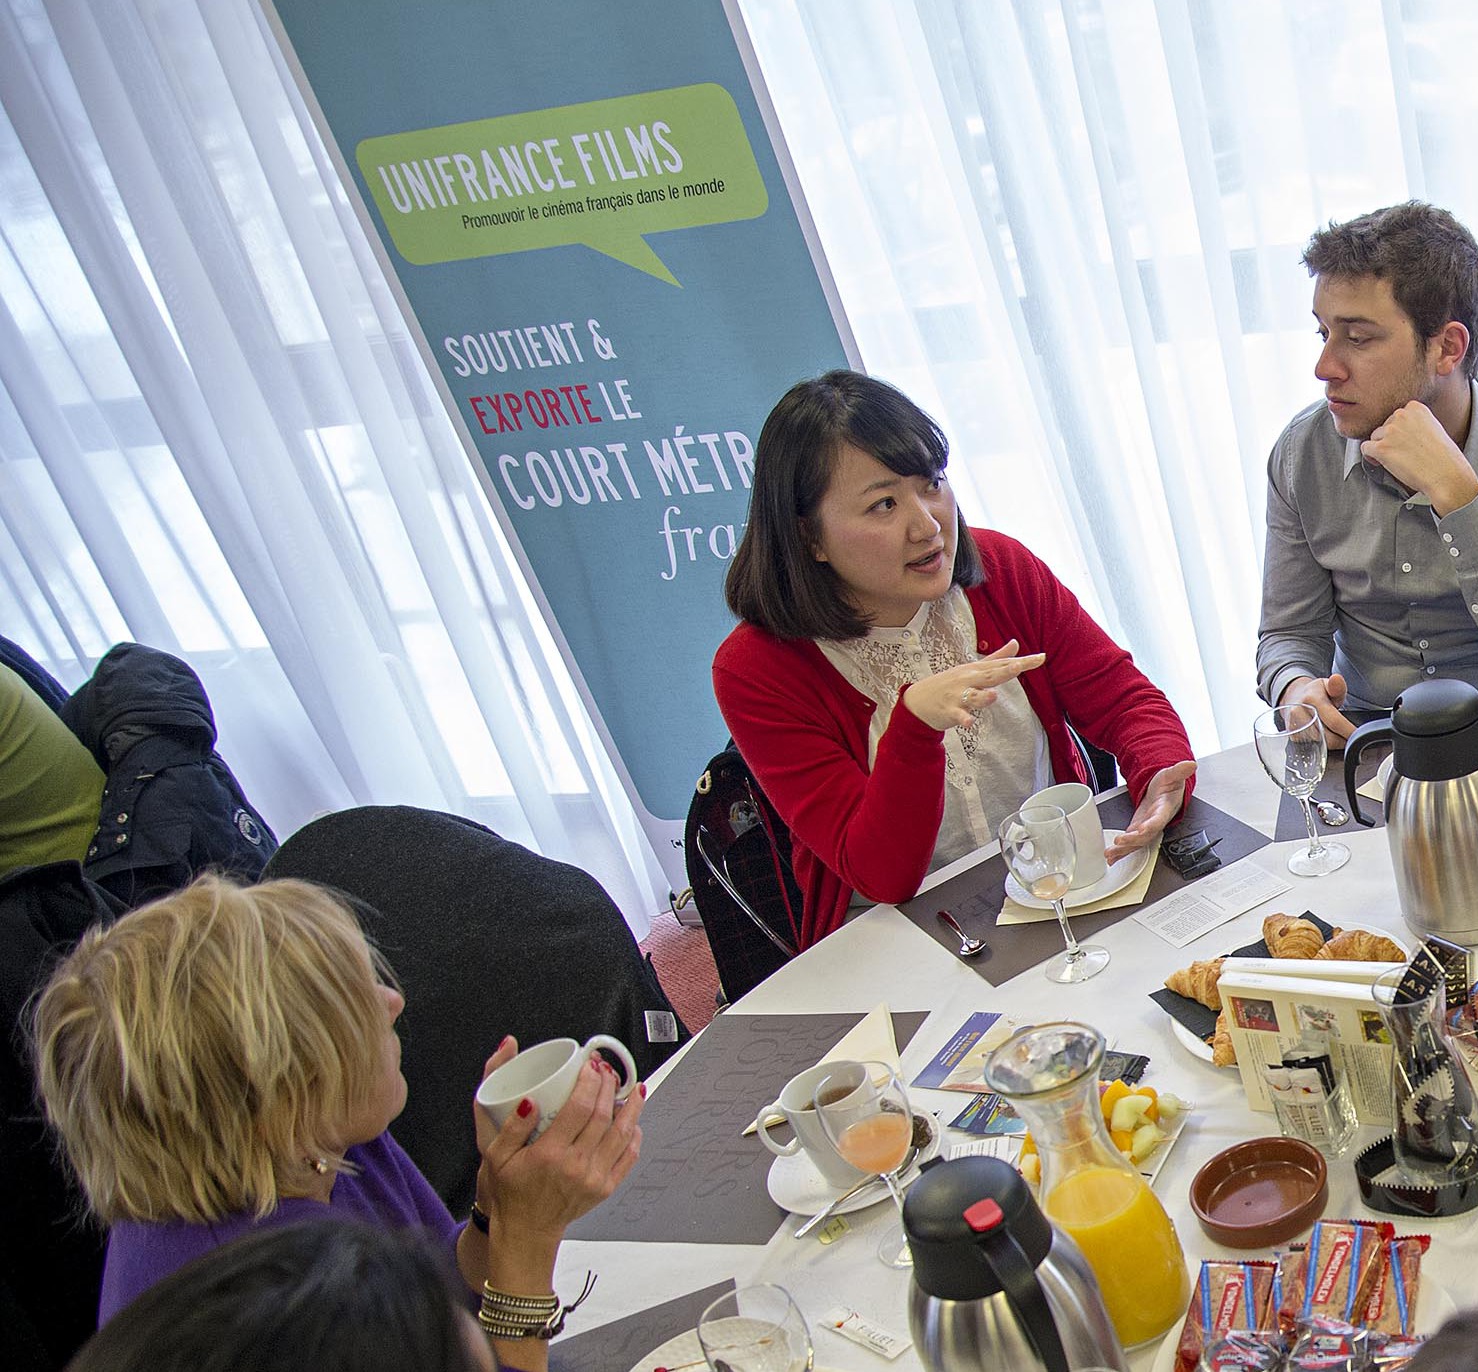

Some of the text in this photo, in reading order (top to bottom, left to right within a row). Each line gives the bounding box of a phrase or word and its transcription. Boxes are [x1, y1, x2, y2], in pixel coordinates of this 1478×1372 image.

[378, 121, 684, 214] UNIFRANCE FILMS
[462, 178, 725, 230] Promouvoir le cinéma français dans le monde
[444, 319, 618, 377] SOUTIENT &
[468, 380, 642, 435] EXPORTE LE
[498, 426, 756, 510] COURT MÉTR
[659, 506, 749, 580] fra
